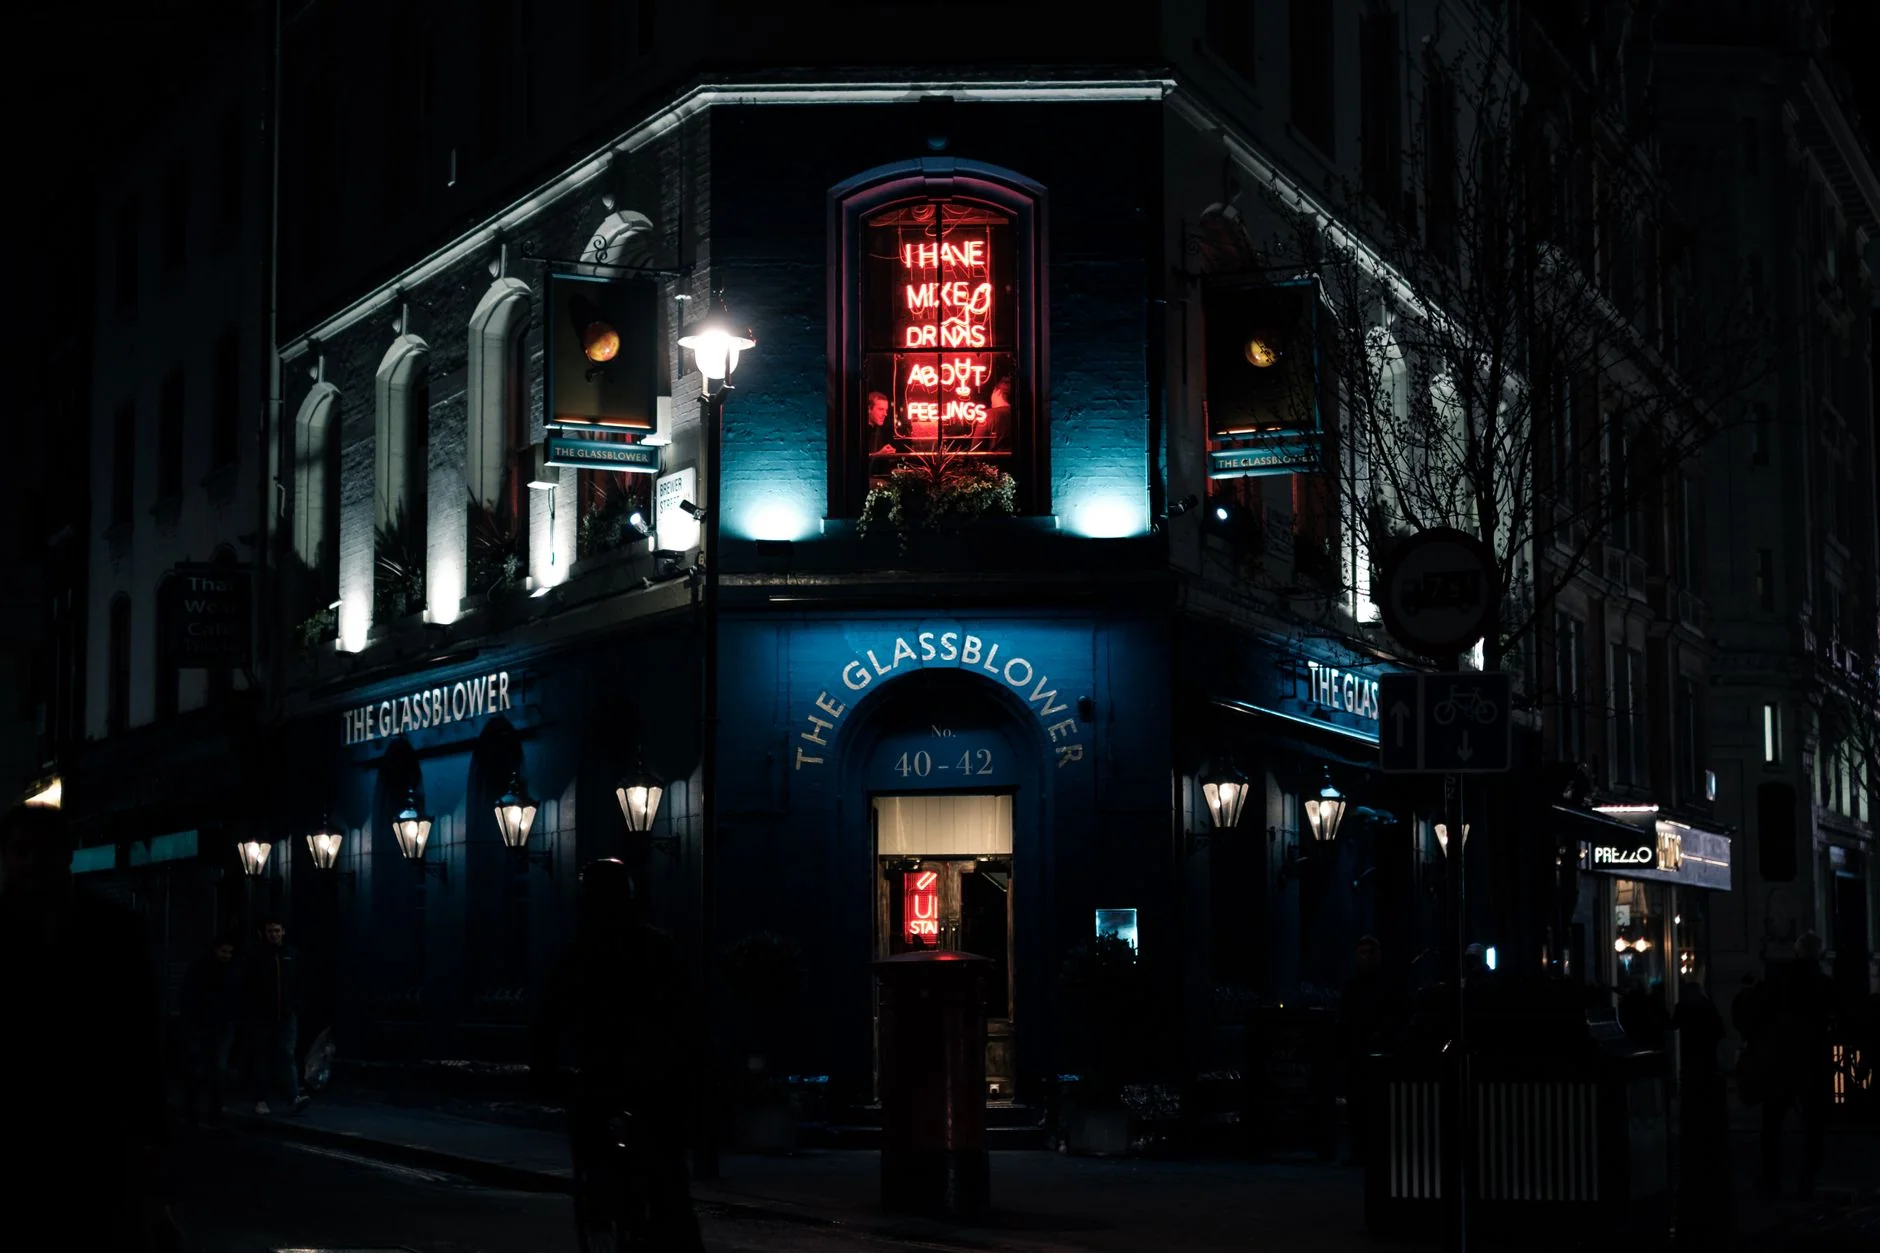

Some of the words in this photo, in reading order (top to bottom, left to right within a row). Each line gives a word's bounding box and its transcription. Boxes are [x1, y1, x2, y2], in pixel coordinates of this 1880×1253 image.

[903, 243, 912, 269] I
[918, 240, 986, 269] HAVE
[906, 325, 986, 349] DRNKS
[907, 358, 987, 393] ABOUT
[554, 447, 575, 458] THE
[577, 449, 649, 462] GLASSBLOWER
[1218, 458, 1239, 469] THE
[1240, 455, 1316, 467] GLASSBLOE
[659, 477, 683, 497] BREWER
[1308, 660, 1339, 708] THE
[343, 704, 375, 745] THE
[379, 671, 511, 738] GLASSBLOWER
[795, 690, 846, 771] THE
[841, 631, 1084, 769] GLASSBLOWER
[931, 724, 957, 739] No.
[1594, 846, 1653, 864] PREZZO
